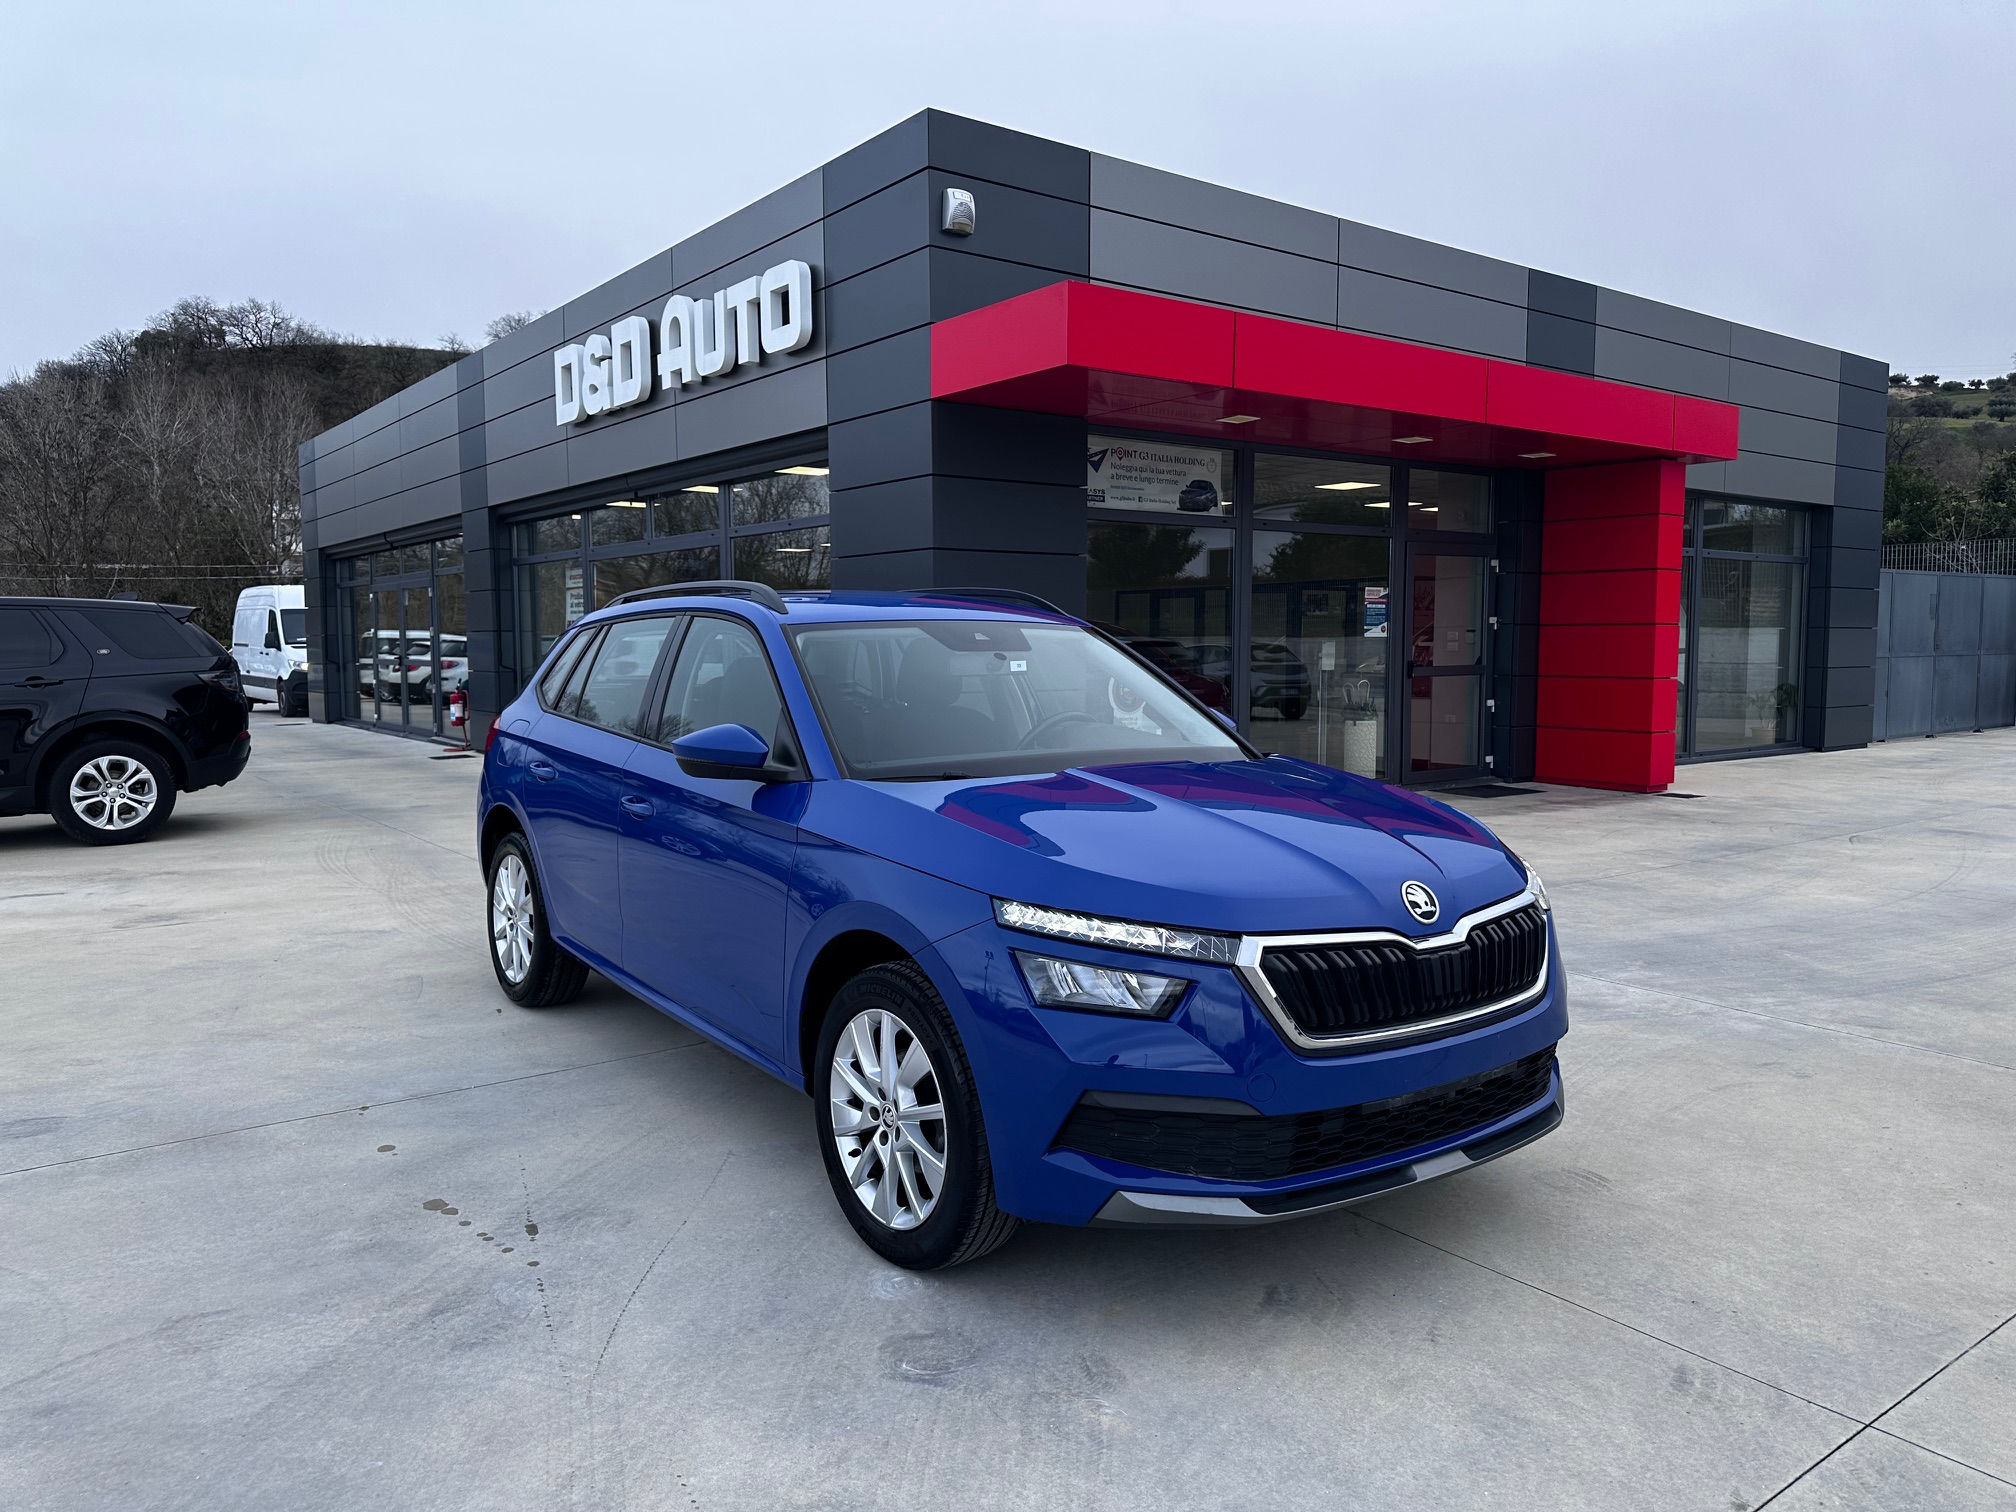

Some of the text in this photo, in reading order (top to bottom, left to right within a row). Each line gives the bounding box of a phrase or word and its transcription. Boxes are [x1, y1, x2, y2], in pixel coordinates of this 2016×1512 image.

[554, 259, 813, 427] D&D AUTO
[1110, 447, 1205, 467] POINT G3 ITALIA HOLDING
[1110, 462, 1138, 474] Noleggia
[1138, 465, 1148, 474] qui
[1165, 468, 1187, 477] vettura
[1115, 473, 1134, 482] breve
[1140, 474, 1156, 485] lungo
[1156, 478, 1179, 486] termine
[857, 983, 905, 1008] MICHELIN
